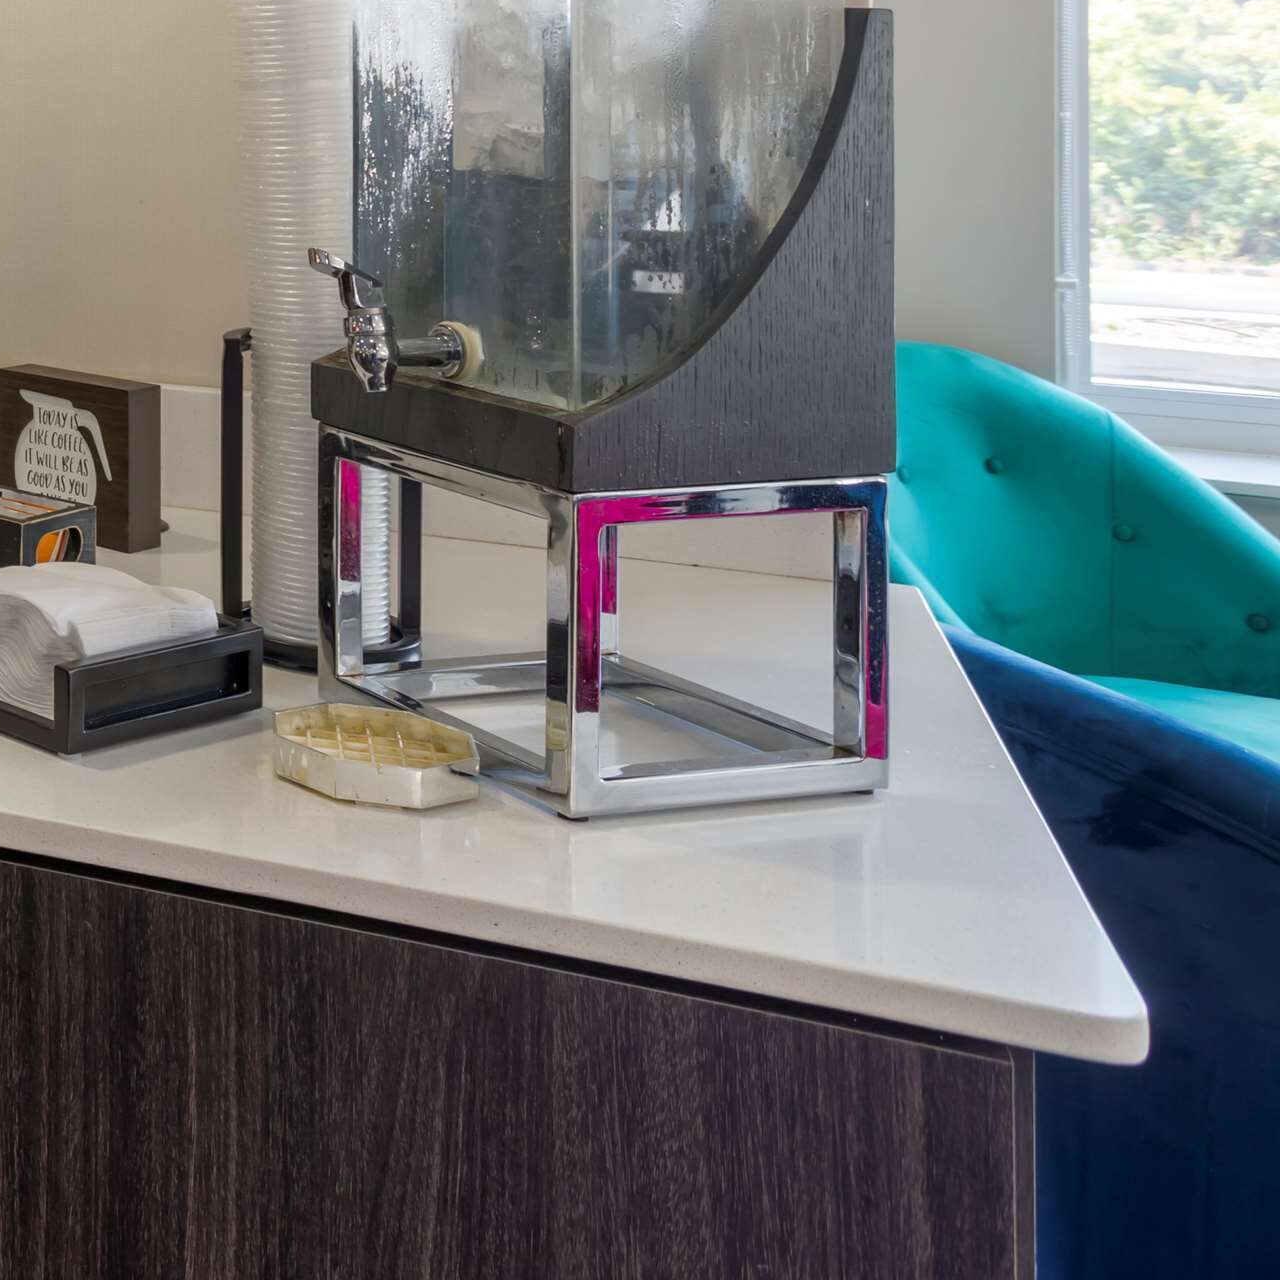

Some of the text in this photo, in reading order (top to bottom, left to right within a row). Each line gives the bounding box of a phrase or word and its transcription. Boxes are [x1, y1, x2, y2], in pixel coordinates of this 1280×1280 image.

[37, 407, 78, 431] TODAY IS
[29, 428, 86, 455] LIKE COFFEE,
[25, 448, 88, 477] IT WILL BE AS
[27, 470, 52, 488] GOOD
[53, 475, 65, 493] AS
[68, 479, 88, 497] YOU
